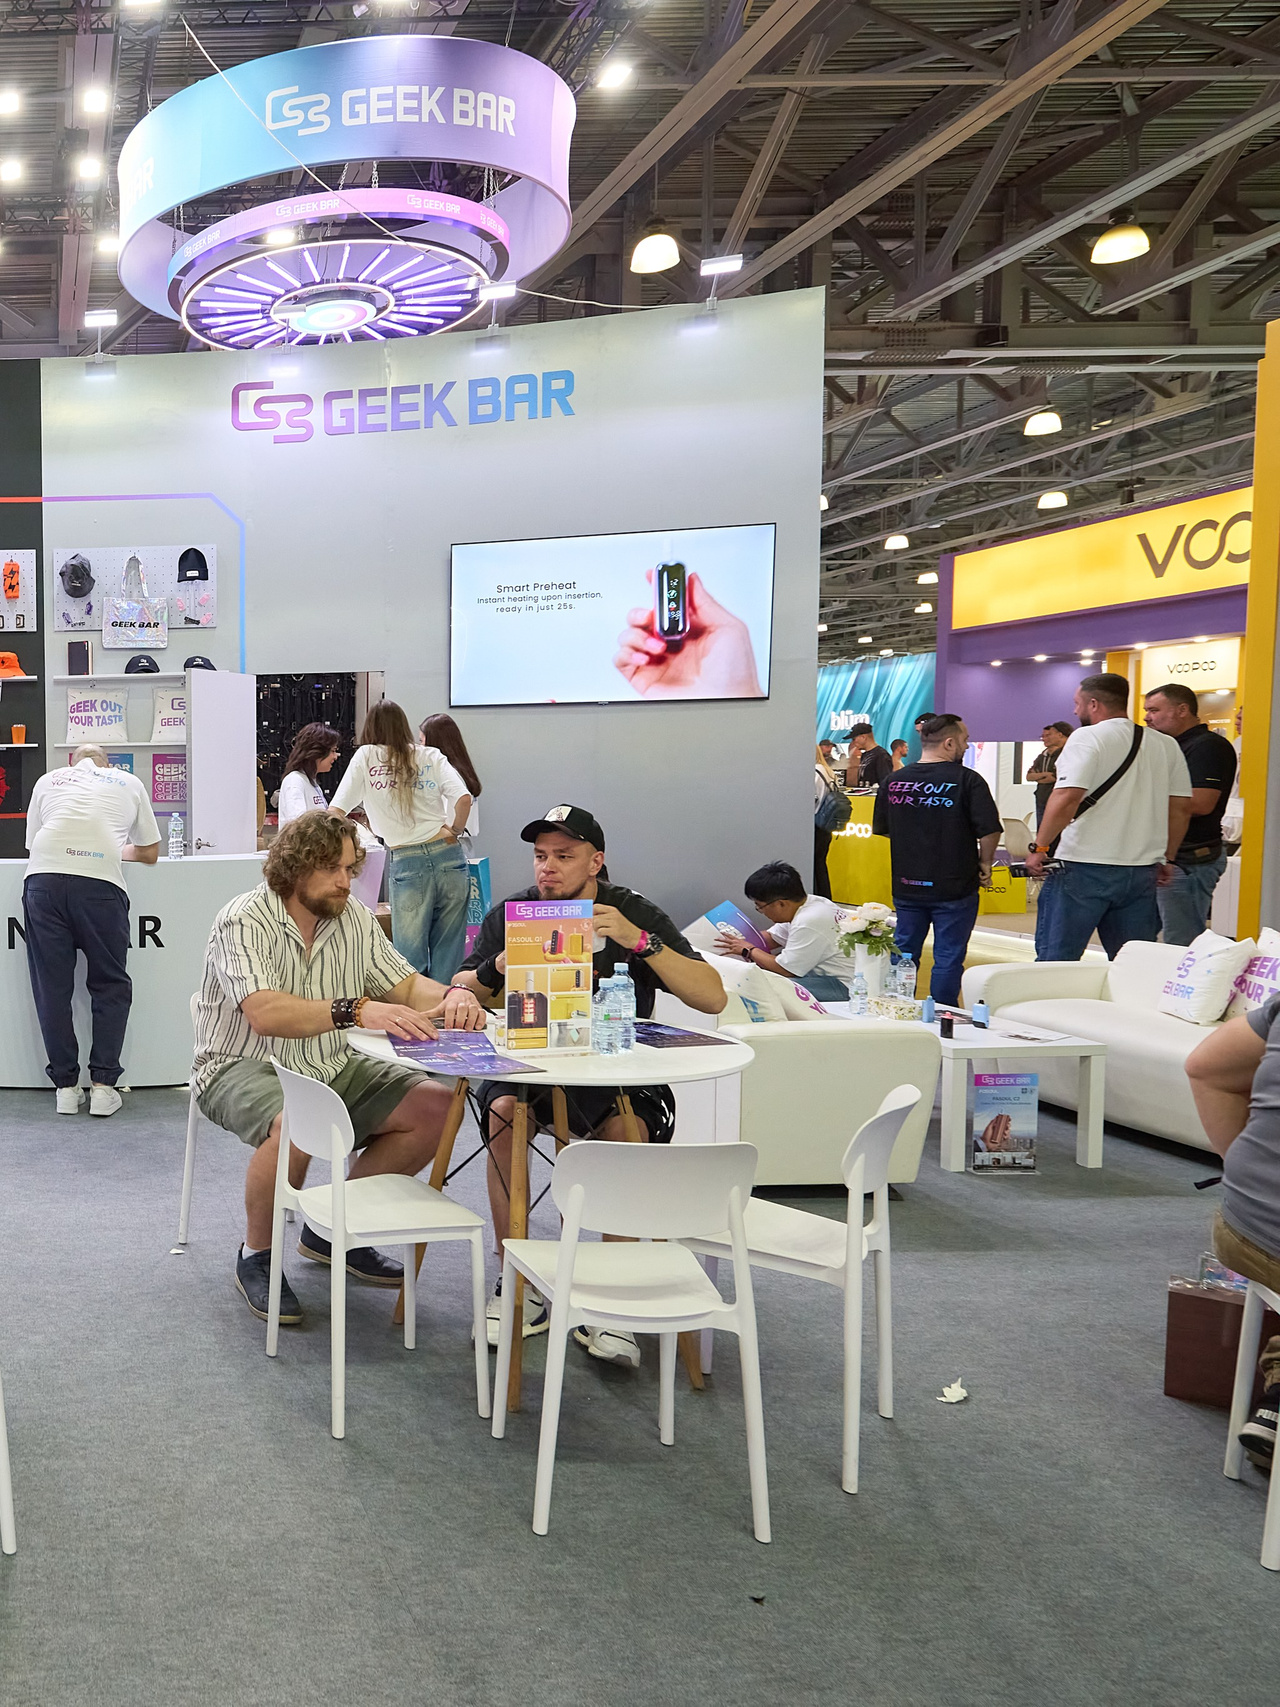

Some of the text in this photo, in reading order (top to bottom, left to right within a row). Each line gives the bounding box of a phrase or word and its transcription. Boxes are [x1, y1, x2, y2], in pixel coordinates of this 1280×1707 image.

[342, 85, 516, 137] GEEK BAR
[293, 198, 340, 215] GEEK BAR
[423, 199, 461, 214] GEEK BAR
[207, 229, 221, 244] BAR
[323, 369, 575, 436] GEEK BAR
[496, 581, 577, 594] Smart Preheat
[477, 596, 505, 604] Instant
[507, 594, 539, 604] heating
[541, 592, 563, 602] upon
[496, 604, 522, 614] ready
[525, 604, 534, 612] in
[536, 603, 554, 613] just
[137, 621, 160, 629] BAR
[1167, 660, 1217, 674] VOOPOO
[69, 699, 123, 714] GEEK OUT
[69, 714, 124, 727] YOUR TASTE
[160, 717, 186, 727] GEEK
[155, 763, 187, 775] GEEK
[888, 781, 958, 794] GEEK OUT
[534, 905, 583, 917] GEEK BAR
[995, 1077, 1031, 1085] GEEK BAR
